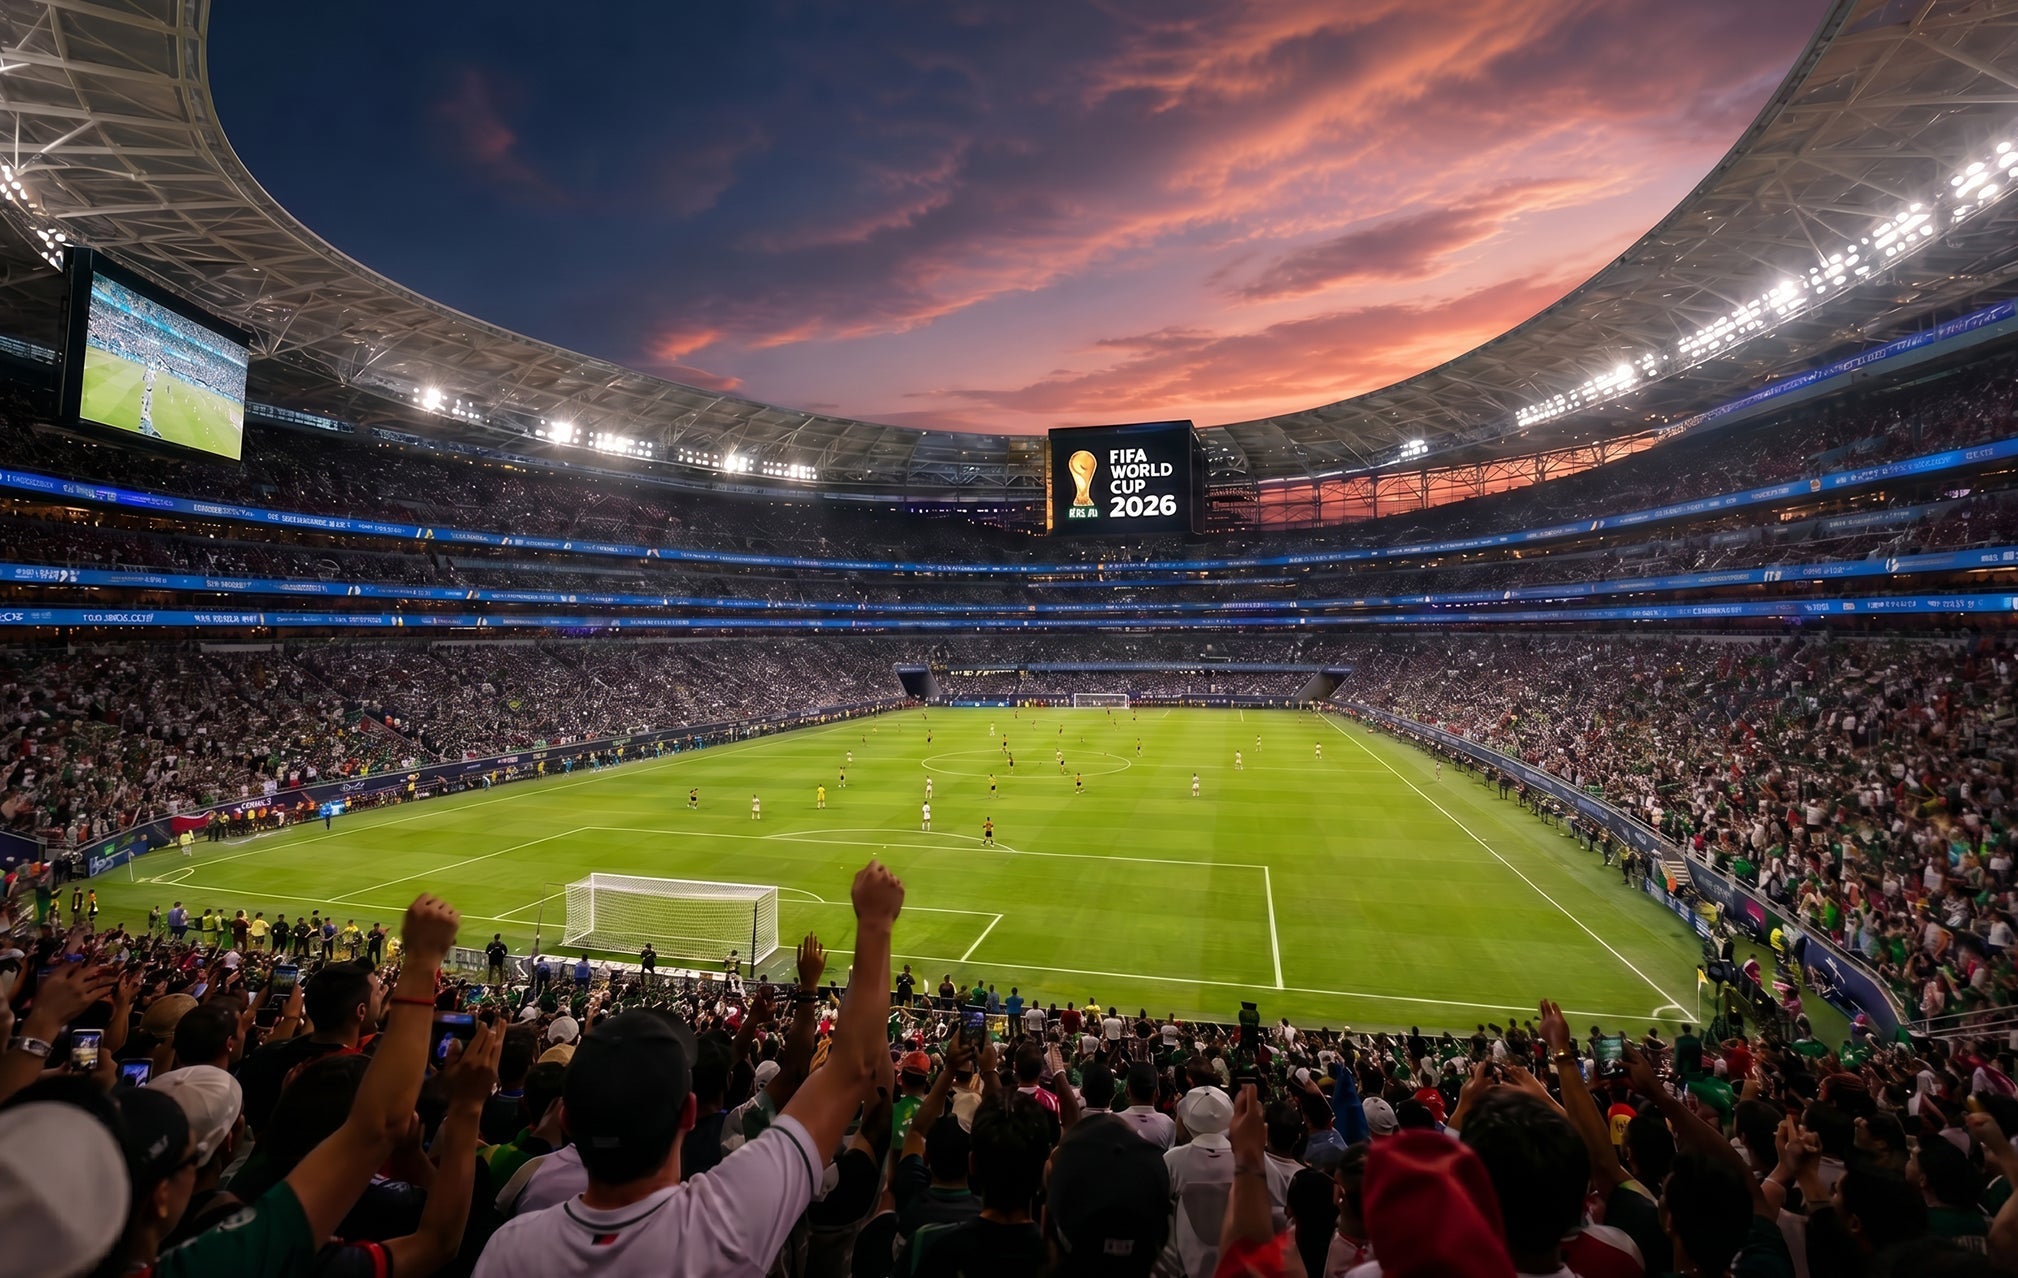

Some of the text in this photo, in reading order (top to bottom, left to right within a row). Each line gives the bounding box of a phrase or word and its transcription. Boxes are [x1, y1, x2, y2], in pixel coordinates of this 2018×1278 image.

[1110, 449, 1147, 464] FIFA
[1111, 463, 1172, 478] WORLD
[1111, 479, 1145, 494] CUP
[1110, 495, 1176, 517] 2026
